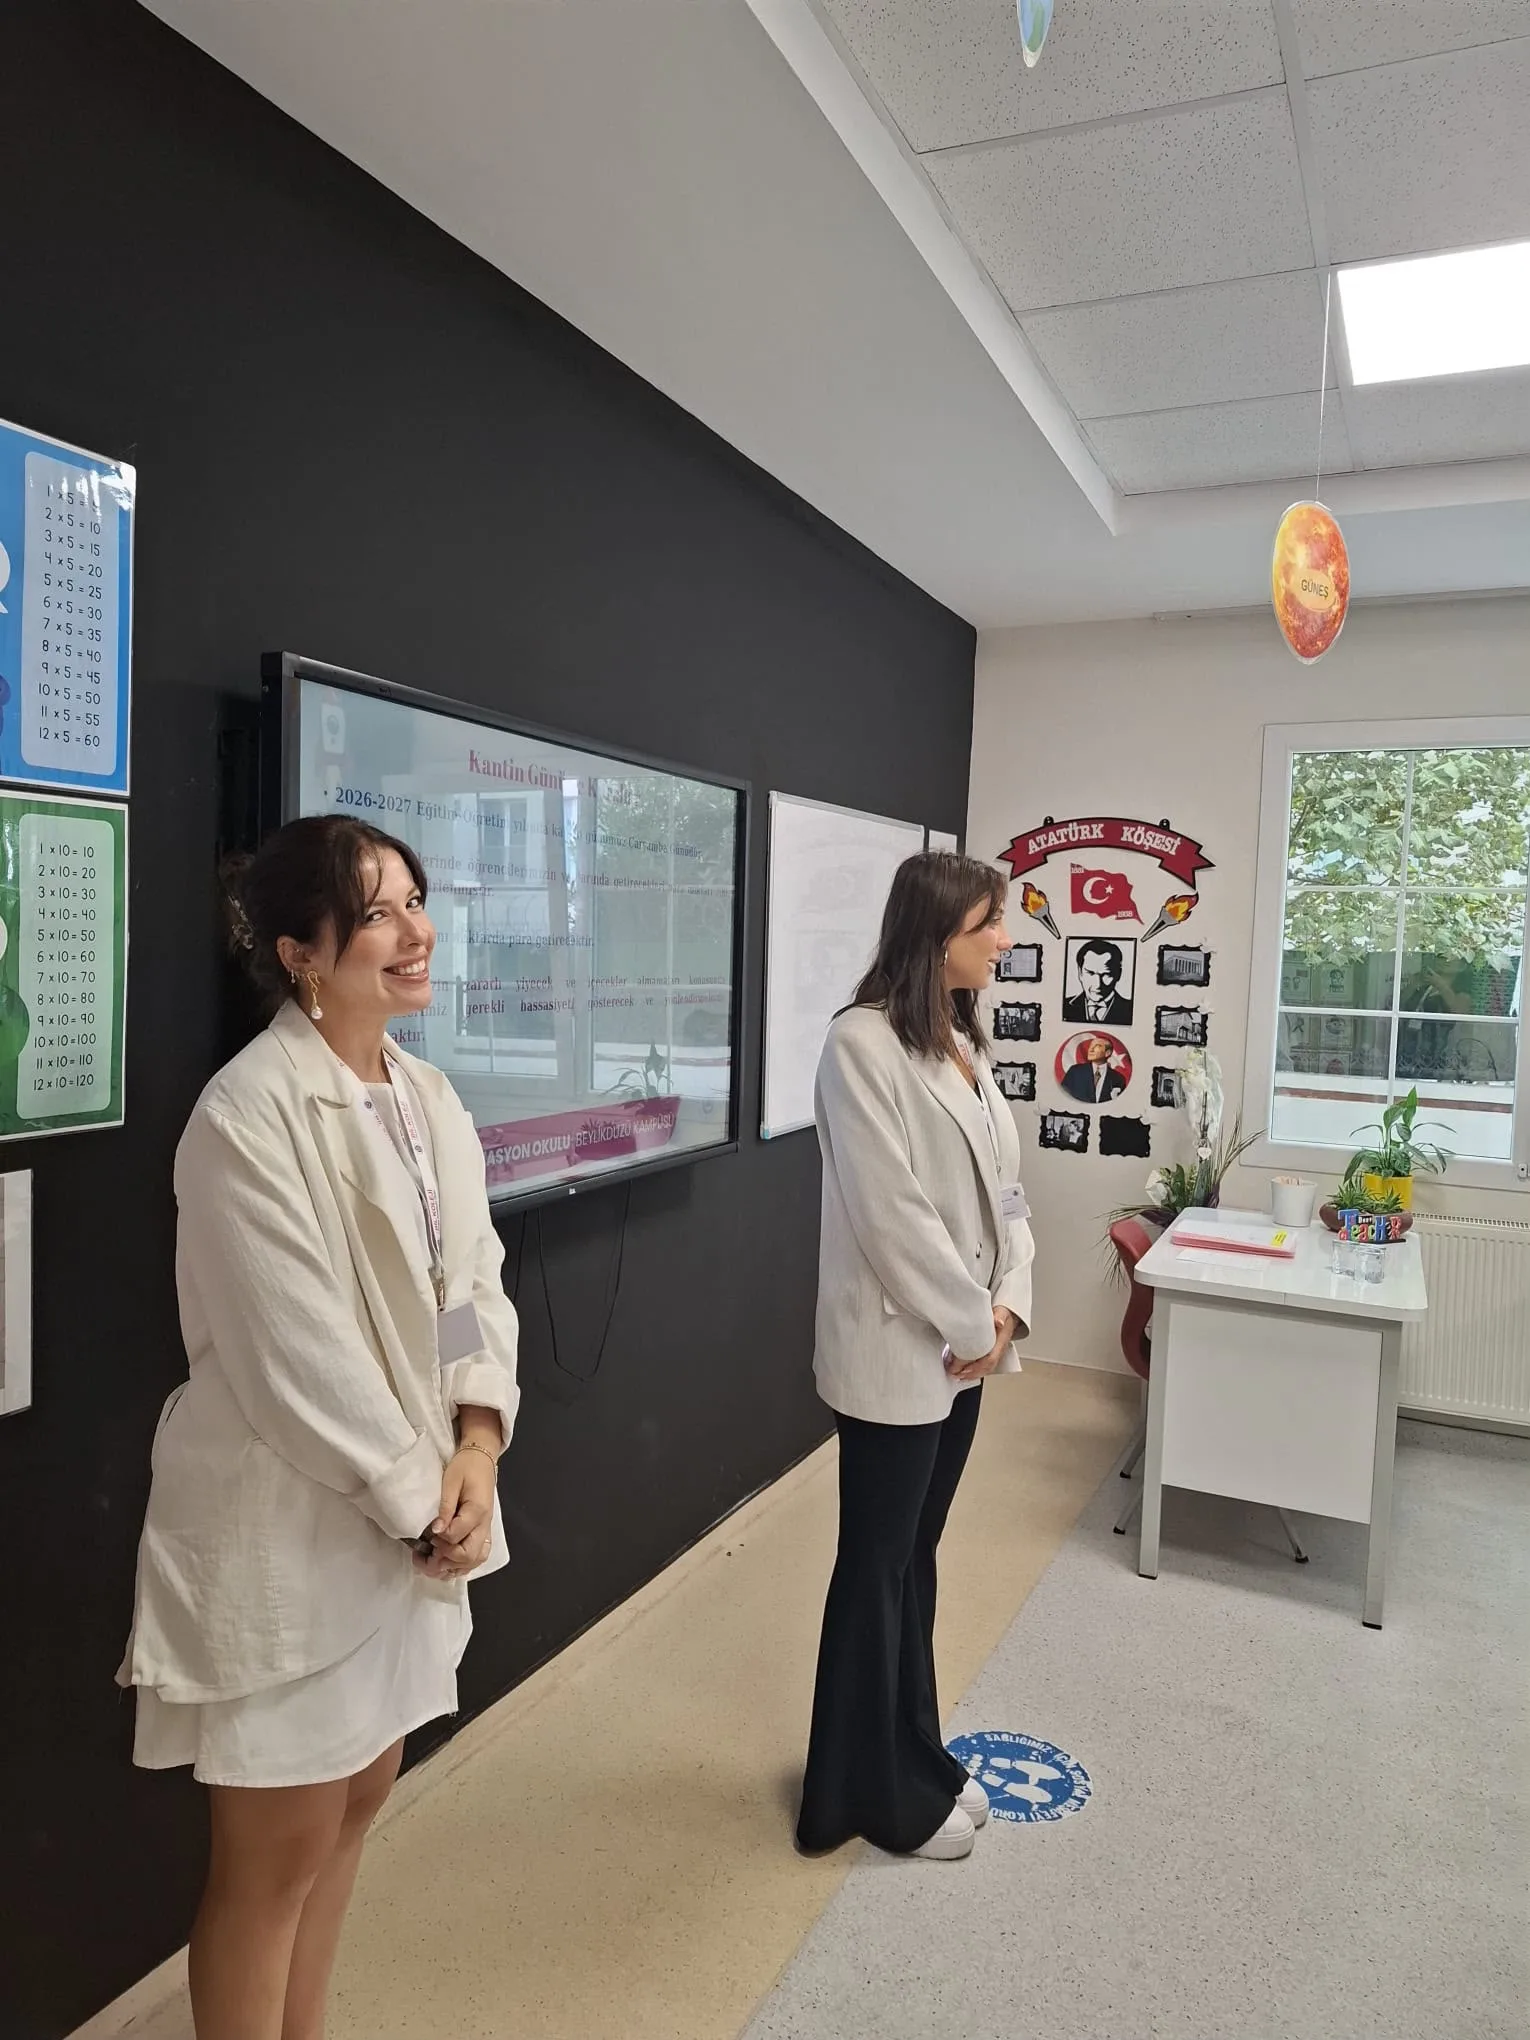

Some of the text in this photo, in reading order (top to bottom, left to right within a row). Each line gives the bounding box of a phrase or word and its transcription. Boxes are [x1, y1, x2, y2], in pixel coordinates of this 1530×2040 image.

[47, 485, 50, 497] 1
[67, 492, 74, 505] 5
[45, 507, 52, 520] 2
[67, 513, 74, 527] 5
[90, 521, 101, 535] 10
[44, 529, 52, 542] 3
[67, 535, 74, 549] 5
[90, 543, 100, 557] 15
[45, 551, 52, 564] 4
[67, 557, 74, 571] 5
[88, 564, 103, 578] 20
[44, 573, 52, 586] 5
[66, 579, 74, 592] 5
[88, 585, 102, 600] 25
[1301, 578, 1329, 600] GÜNEŞ
[43, 595, 51, 608] 6
[66, 600, 73, 614] 5
[87, 606, 102, 621] 30
[43, 617, 50, 630] 7
[65, 622, 73, 636] 5
[87, 628, 101, 642] 35
[42, 639, 49, 652] 8
[64, 644, 72, 657] 5
[86, 649, 102, 663] 40
[41, 662, 49, 674] 9
[64, 666, 71, 679] 5
[86, 671, 101, 685] 45
[39, 682, 51, 696] 10
[63, 687, 71, 700] 5
[85, 691, 101, 705] 50
[41, 704, 47, 717] 11
[63, 709, 70, 722] 5
[85, 712, 100, 727] 55
[39, 726, 49, 740] 12
[63, 730, 70, 743] 5
[84, 734, 100, 747] 60
[469, 750, 524, 783] Kantin
[335, 786, 412, 813] 2026-2027
[1028, 822, 1182, 856] ATATÜRK KÖŞESİ
[40, 842, 43, 855] 1
[59, 844, 70, 857] 10
[83, 846, 94, 858] 10
[38, 864, 45, 877] 2
[59, 865, 70, 878] 10
[82, 867, 96, 879] 20
[38, 885, 45, 899] 3
[59, 887, 70, 899] 10
[81, 888, 96, 900] 30
[38, 907, 45, 920] 4
[59, 908, 70, 920] 10
[81, 909, 96, 921] 40
[37, 929, 45, 941] 5
[58, 929, 70, 941] 10
[81, 929, 96, 942] 50
[37, 950, 44, 963] 6
[58, 950, 69, 963] 10
[80, 950, 95, 963] 60
[37, 972, 44, 984] 7
[58, 971, 69, 983] 10
[80, 971, 96, 983] 70
[37, 993, 44, 1006] 8
[58, 993, 69, 1005] 10
[80, 992, 95, 1004] 80
[466, 999, 505, 1017] gerekli
[37, 1015, 44, 1027] 9
[58, 1014, 69, 1026] 10
[80, 1012, 95, 1024] 90
[34, 1036, 46, 1048] 10
[57, 1034, 69, 1047] 10
[77, 1033, 96, 1045] 100
[391, 1028, 425, 1044] aktır.
[36, 1057, 43, 1070] 11
[56, 1055, 68, 1068] 10
[79, 1053, 93, 1066] 110
[34, 1078, 44, 1091] 12
[56, 1076, 67, 1088] 10
[76, 1074, 94, 1087] 120
[483, 1111, 676, 1168] ASYON OKULU BEYLİKDÜZÜ KAMPÜSÜ
